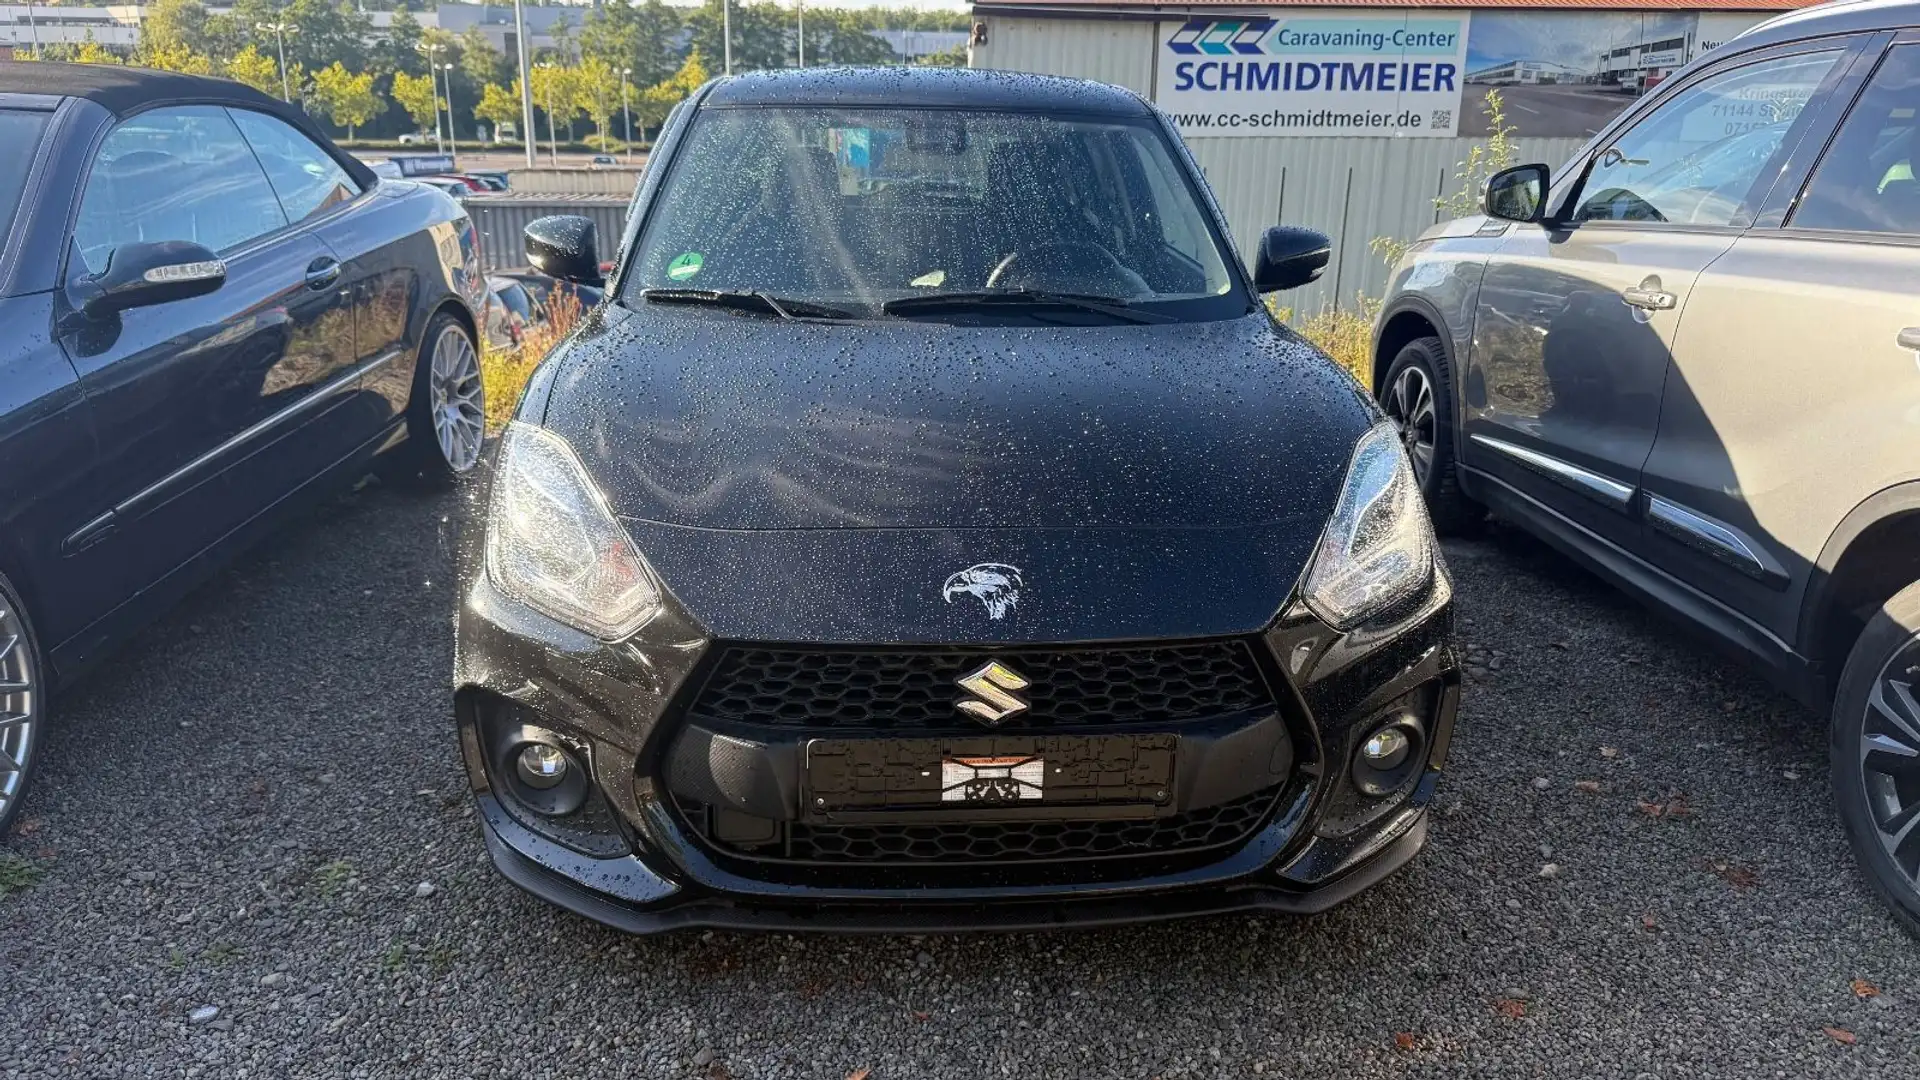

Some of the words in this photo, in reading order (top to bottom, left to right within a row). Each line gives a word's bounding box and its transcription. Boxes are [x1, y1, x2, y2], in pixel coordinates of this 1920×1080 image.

[1278, 28, 1455, 50] Caravaning-Center
[1174, 62, 1456, 92] SCHMIDTMEIER
[1712, 104, 1754, 117] 71144
